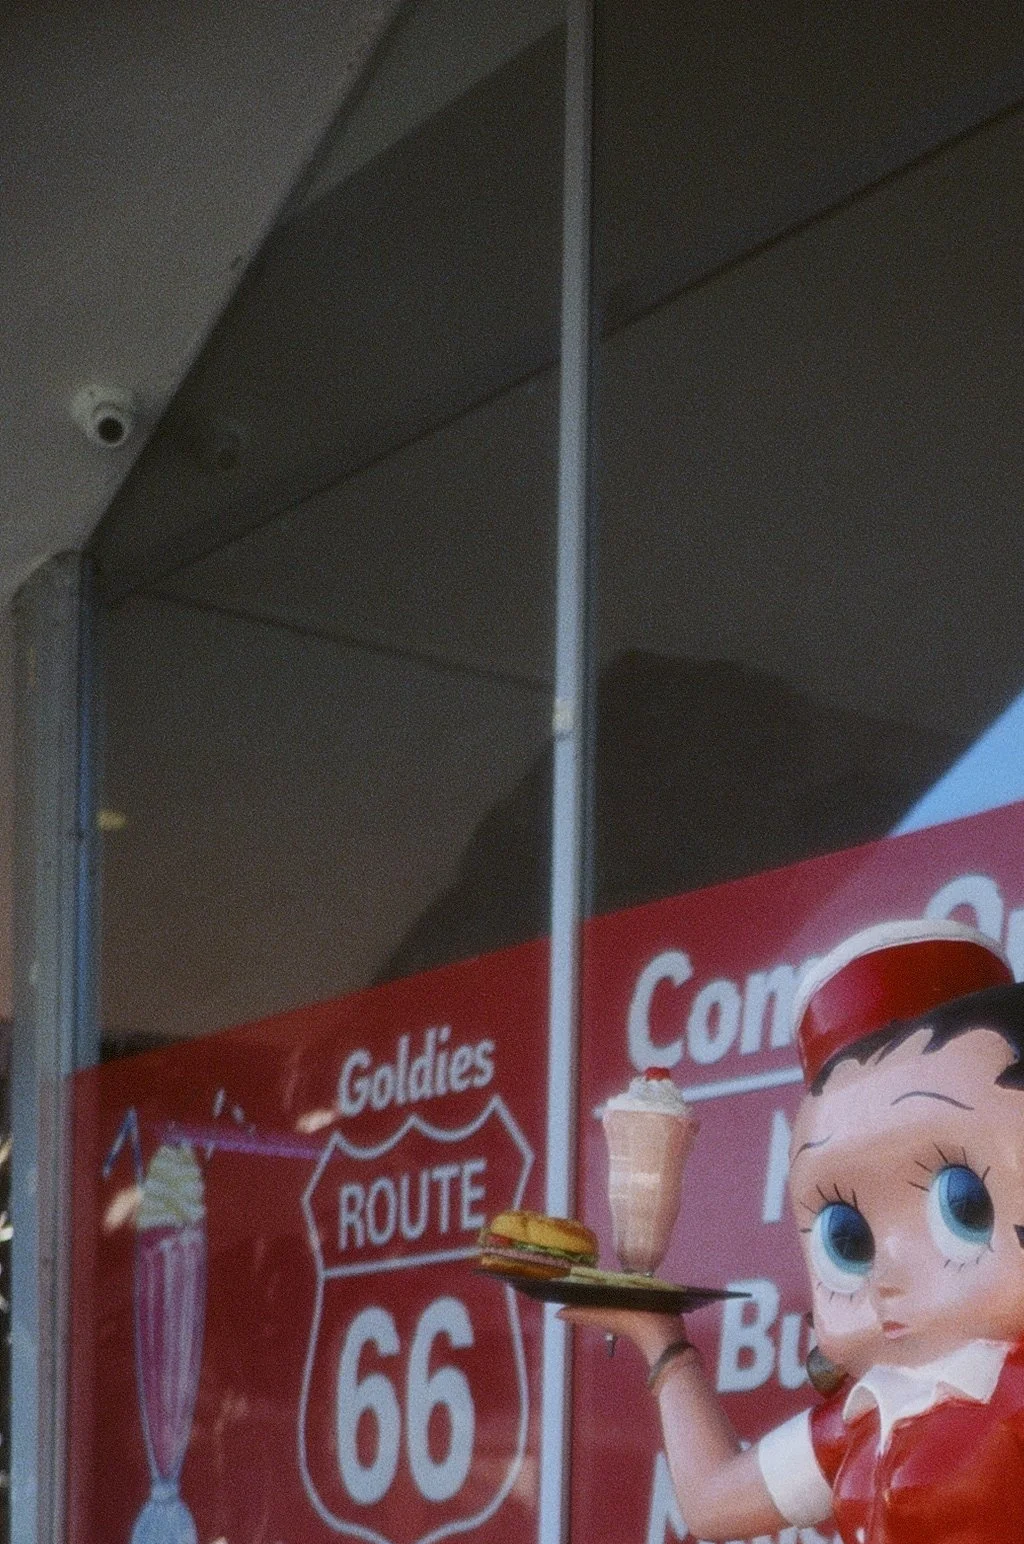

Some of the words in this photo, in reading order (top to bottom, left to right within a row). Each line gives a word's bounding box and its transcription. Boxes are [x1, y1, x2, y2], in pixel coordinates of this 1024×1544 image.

[336, 1025, 496, 1119] Goldies
[338, 1158, 488, 1253] ROUTE
[335, 1295, 476, 1506] 66
